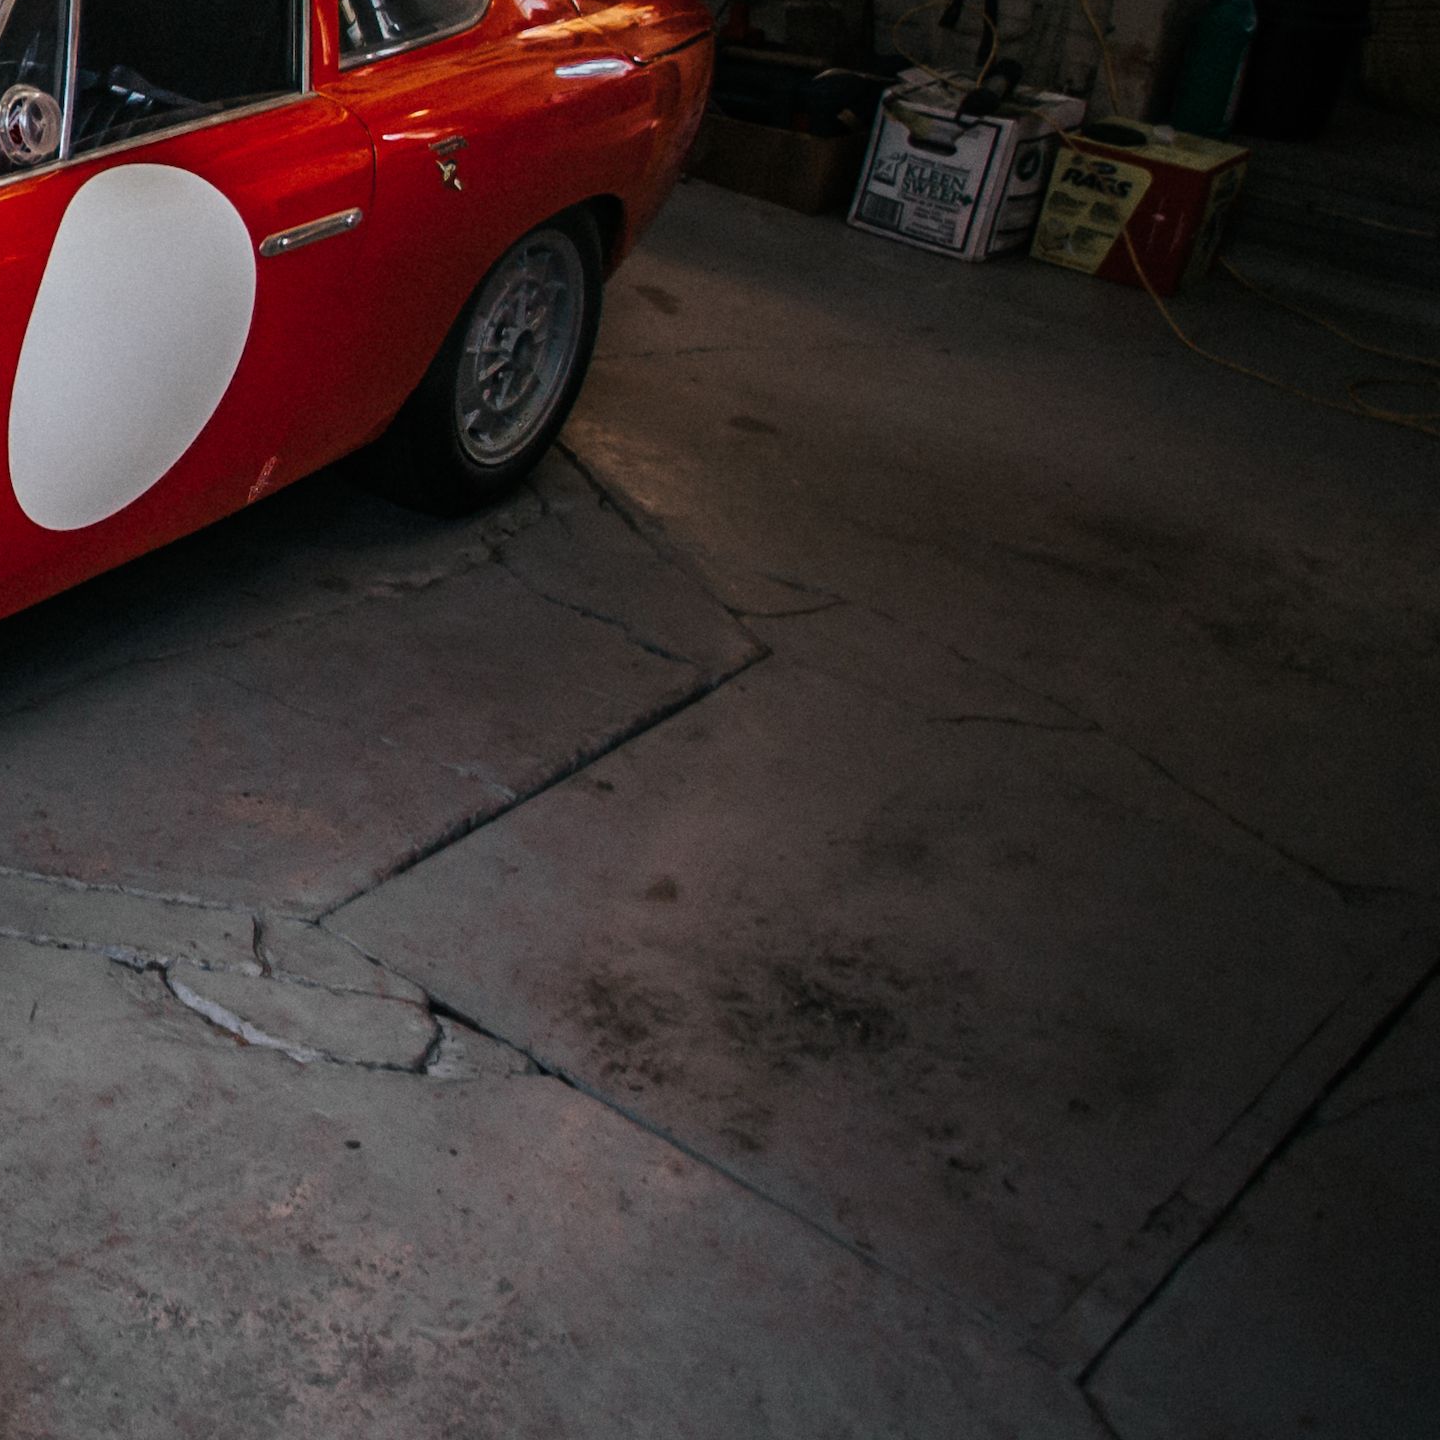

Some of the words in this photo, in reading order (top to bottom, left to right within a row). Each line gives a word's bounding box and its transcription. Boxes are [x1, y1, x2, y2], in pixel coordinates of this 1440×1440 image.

[902, 178, 962, 204] SWEEP
[905, 163, 968, 191] KLEEN
[1060, 167, 1133, 199] RAGS
